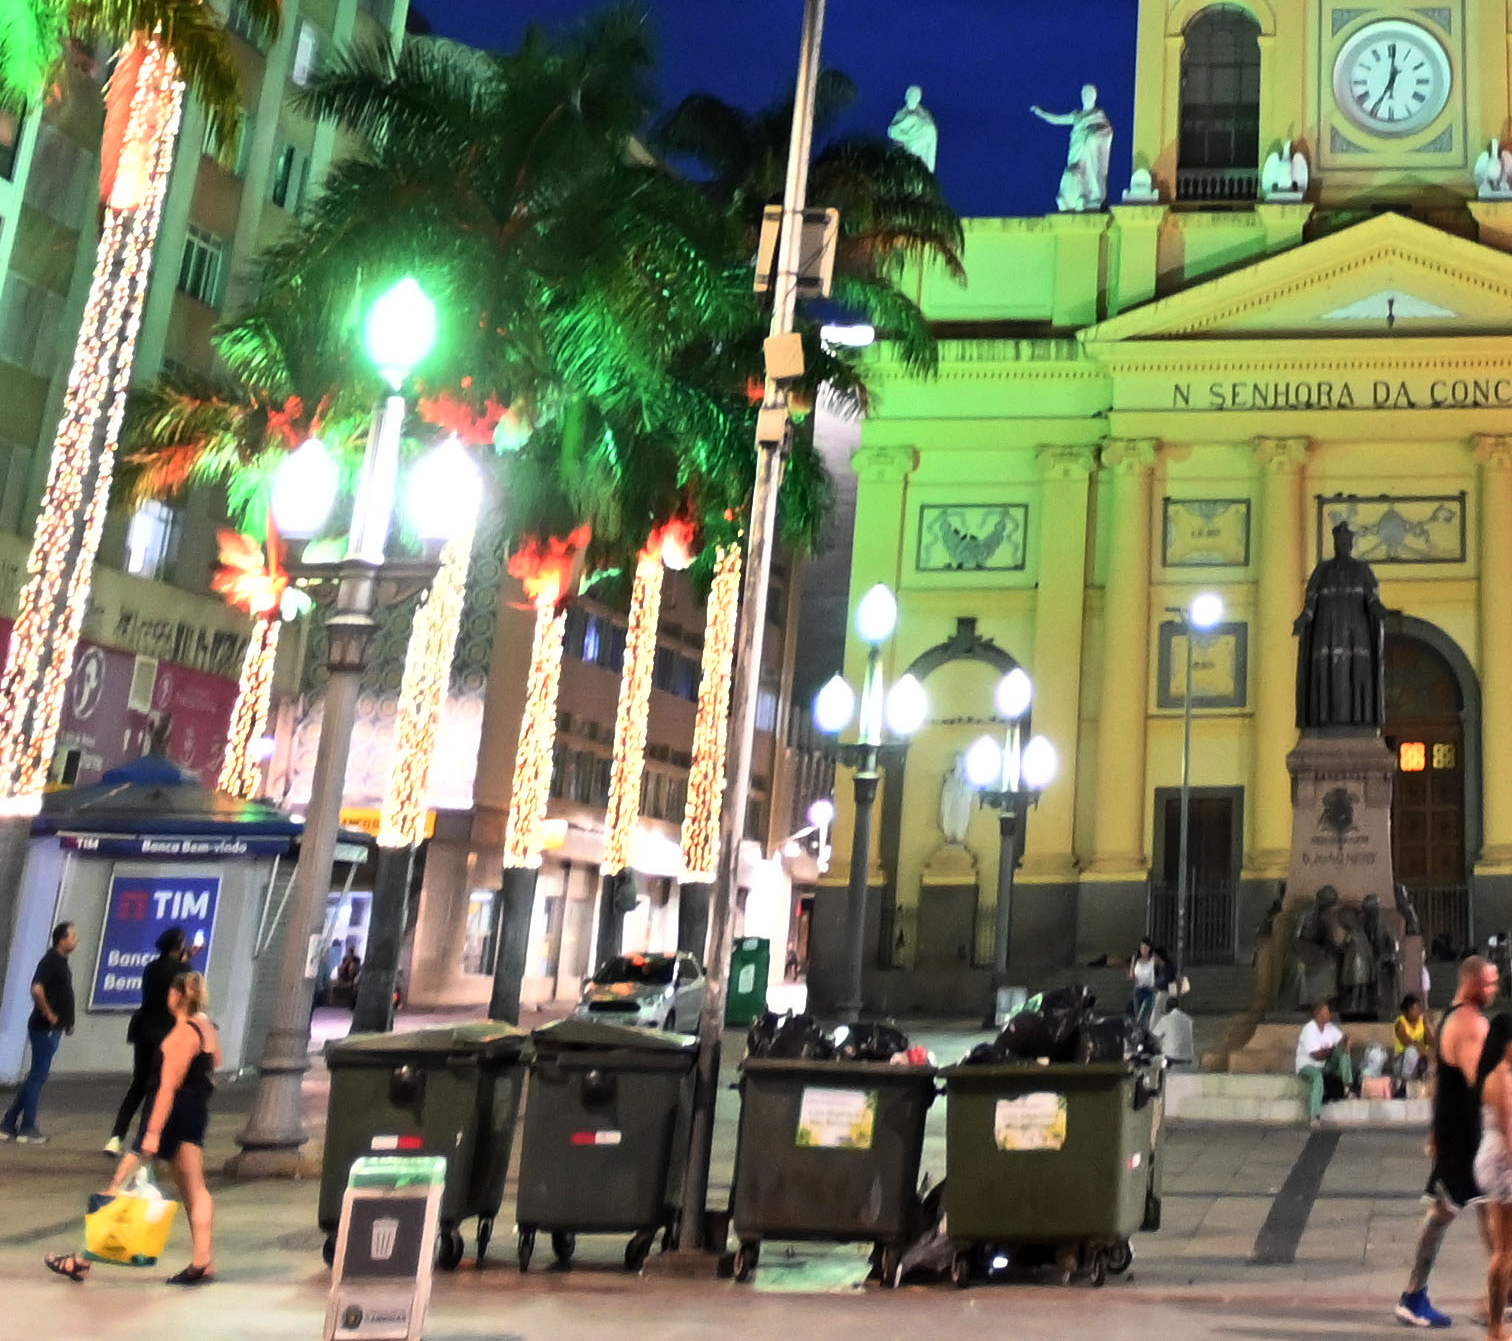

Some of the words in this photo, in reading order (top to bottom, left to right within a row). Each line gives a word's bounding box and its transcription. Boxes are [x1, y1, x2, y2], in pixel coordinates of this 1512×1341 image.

[1209, 382, 1355, 409] SENHORA
[1372, 381, 1410, 406] DA
[76, 837, 100, 851] TIM
[153, 890, 210, 920] TIM
